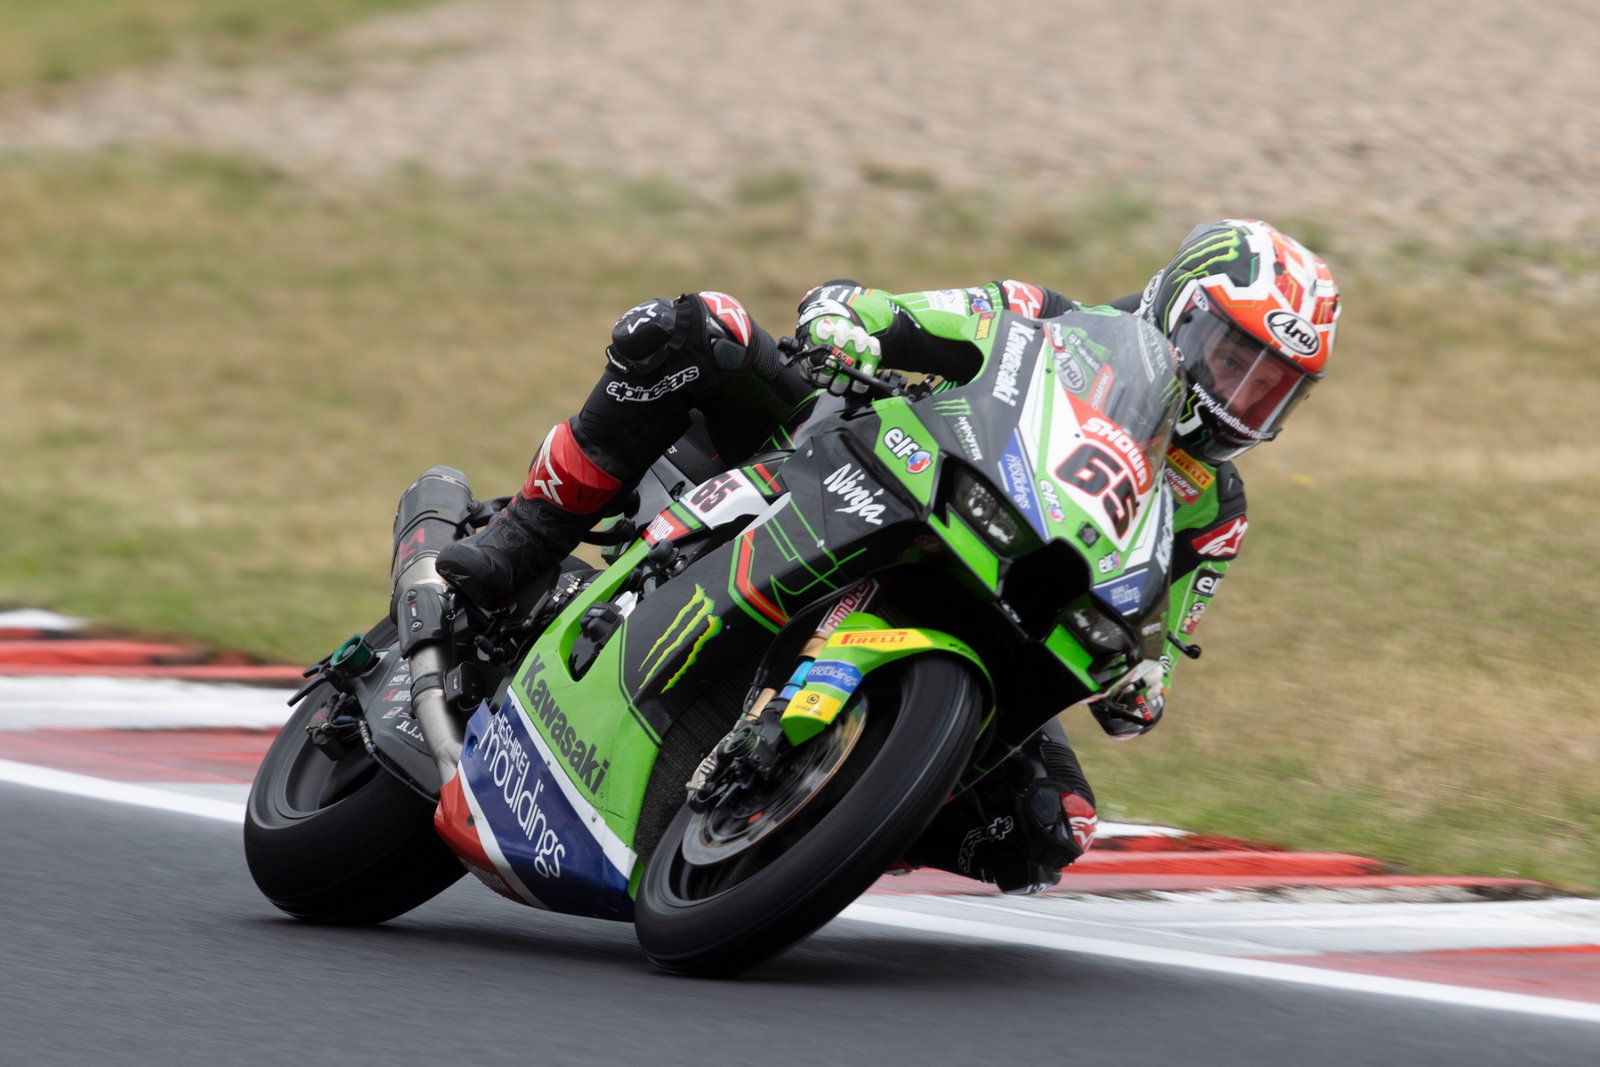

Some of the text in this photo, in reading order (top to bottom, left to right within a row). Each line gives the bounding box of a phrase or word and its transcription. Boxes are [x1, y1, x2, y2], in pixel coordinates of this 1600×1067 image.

[1270, 319, 1314, 350] Arai
[606, 366, 700, 402] alpinestars
[992, 321, 1036, 407] Kawasaki
[884, 428, 918, 464] elf
[957, 416, 984, 460] MONSTER
[1081, 417, 1148, 490] SHOWA
[690, 472, 742, 514] 65
[823, 463, 886, 525] Ninja
[1055, 443, 1138, 540] 65
[840, 632, 908, 645] PIRELLI
[520, 653, 610, 795] Kawasaki
[479, 718, 565, 878] mouldings
